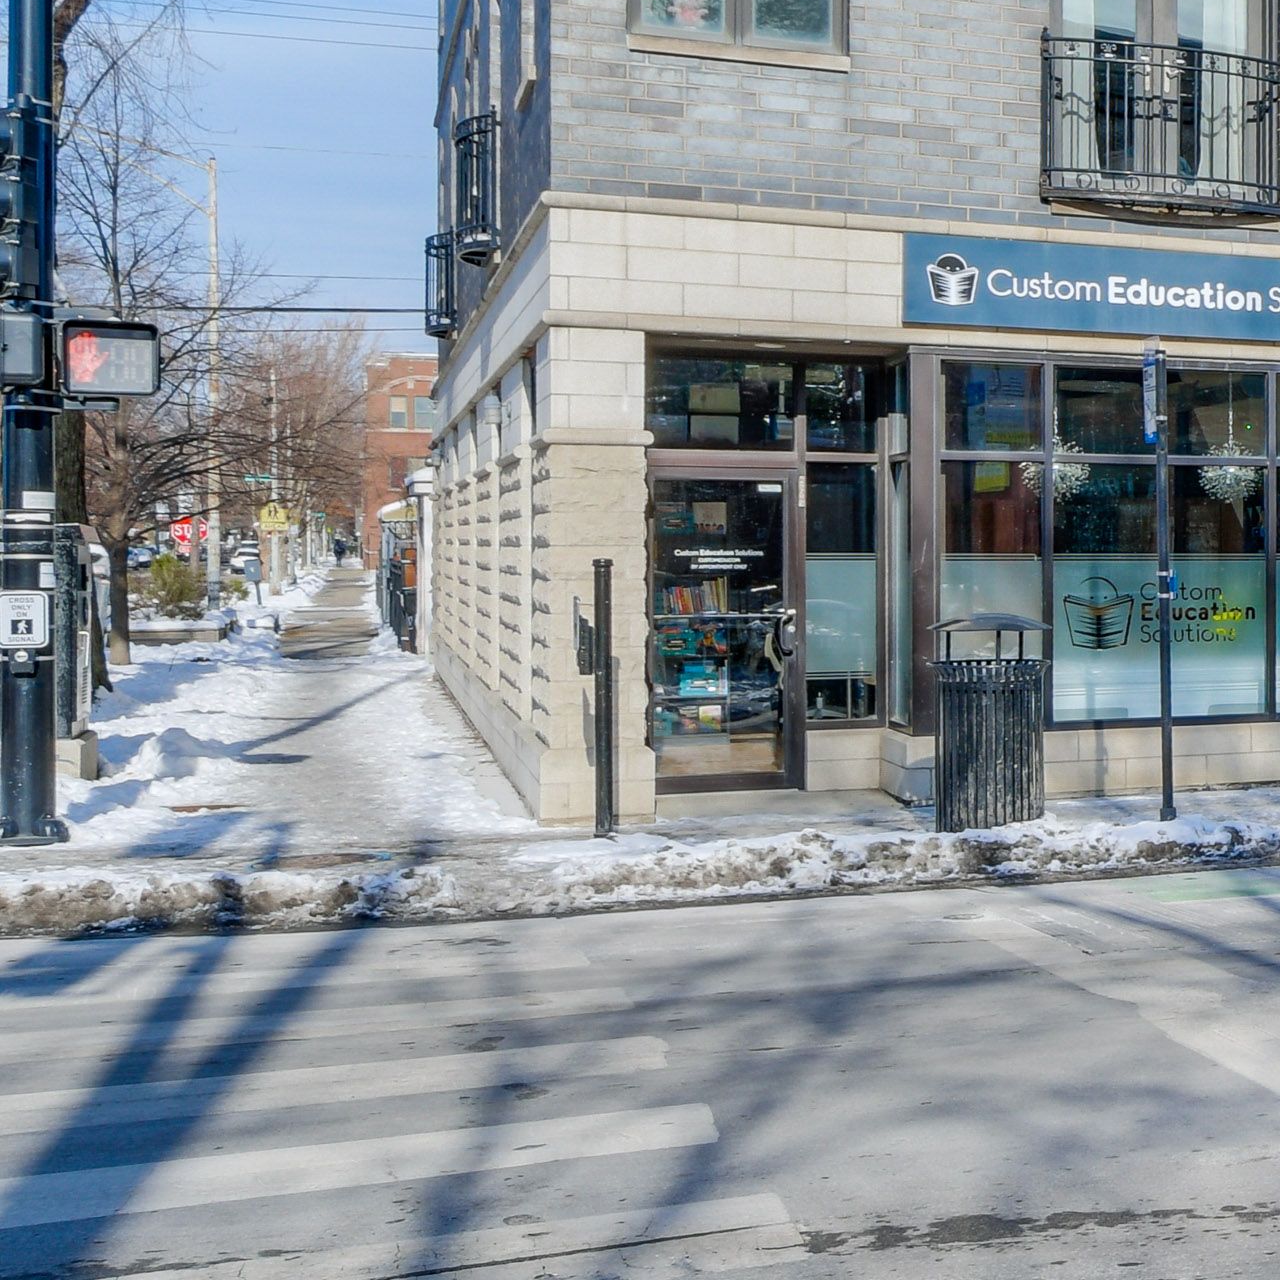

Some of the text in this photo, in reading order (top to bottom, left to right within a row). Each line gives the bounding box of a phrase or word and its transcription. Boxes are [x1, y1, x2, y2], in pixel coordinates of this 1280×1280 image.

[987, 269, 1101, 302] Custom
[1108, 275, 1262, 313] Education
[1140, 582, 1222, 601] Ctom
[1141, 602, 1256, 621] Eucation
[1140, 625, 1236, 644] Soutions
